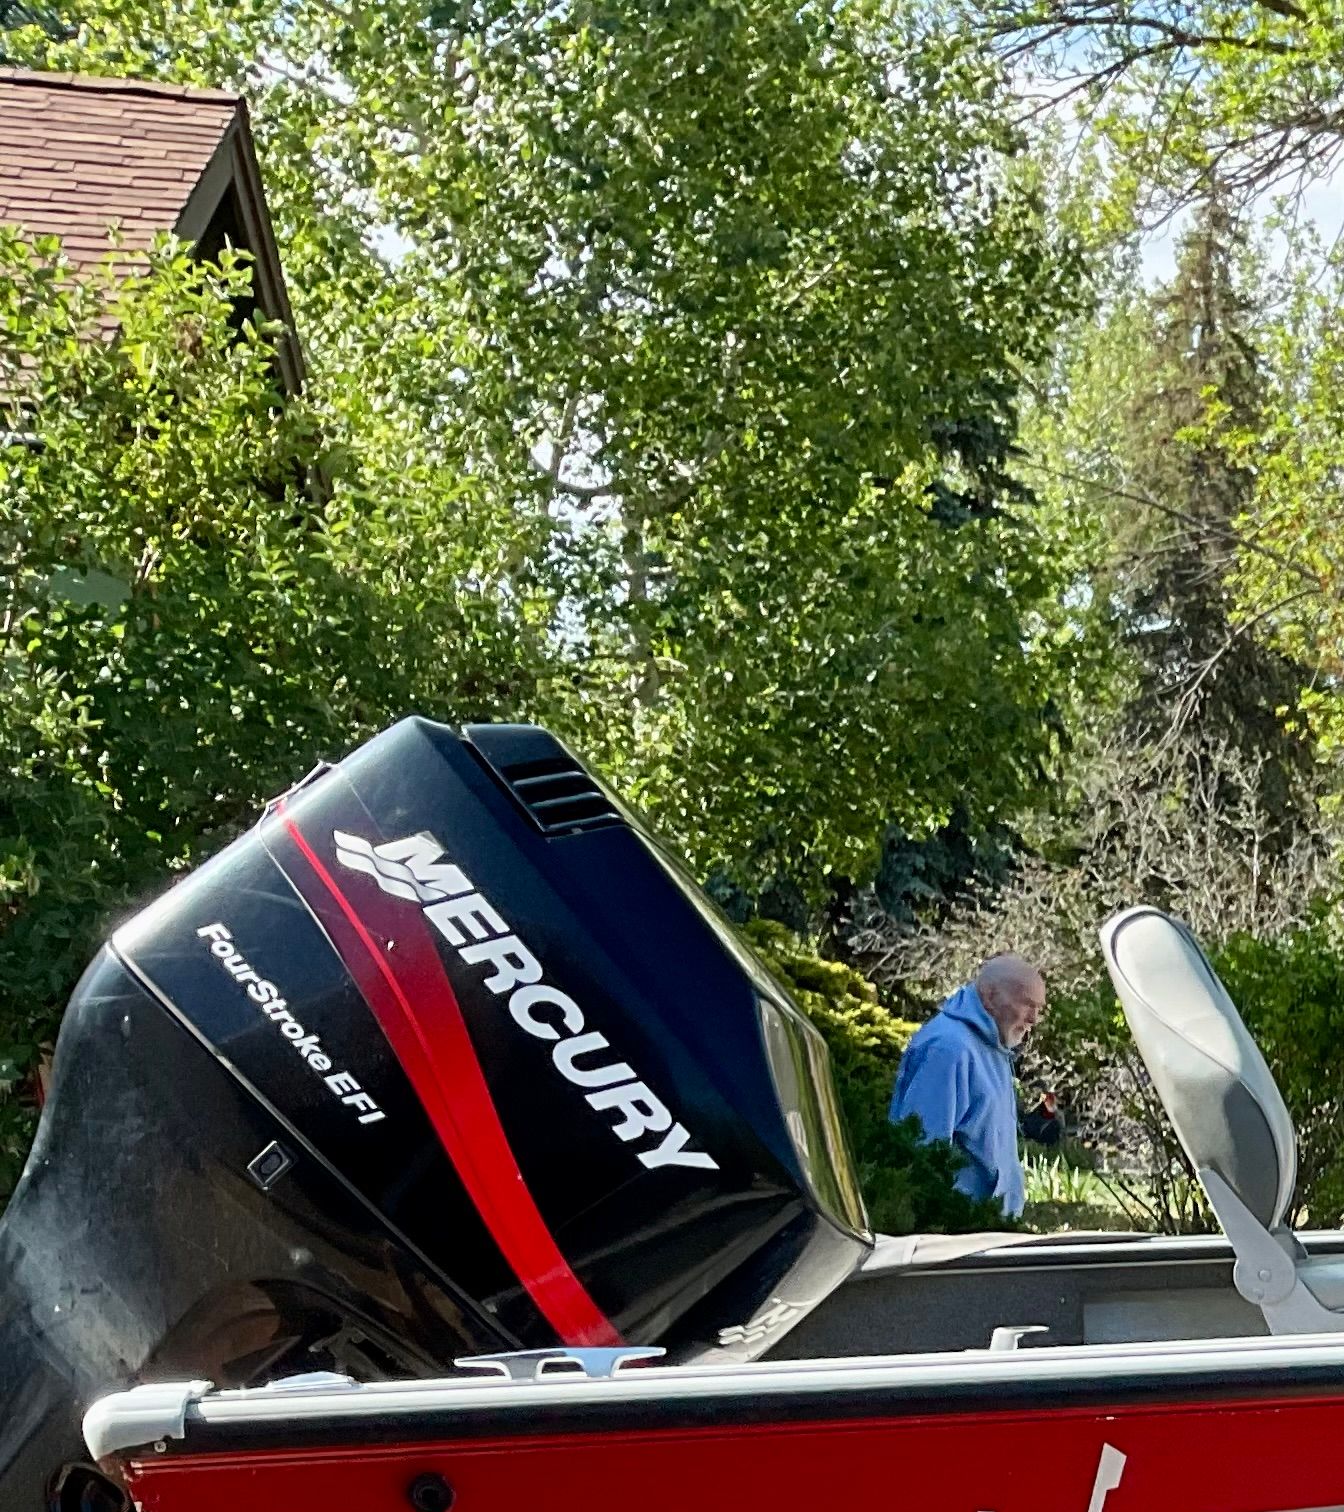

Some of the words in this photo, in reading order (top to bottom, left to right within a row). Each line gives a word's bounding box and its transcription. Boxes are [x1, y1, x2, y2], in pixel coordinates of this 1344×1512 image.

[196, 921, 333, 1072] FourStroke
[322, 1069, 388, 1125] EFI
[333, 829, 720, 1173] MERCURY
